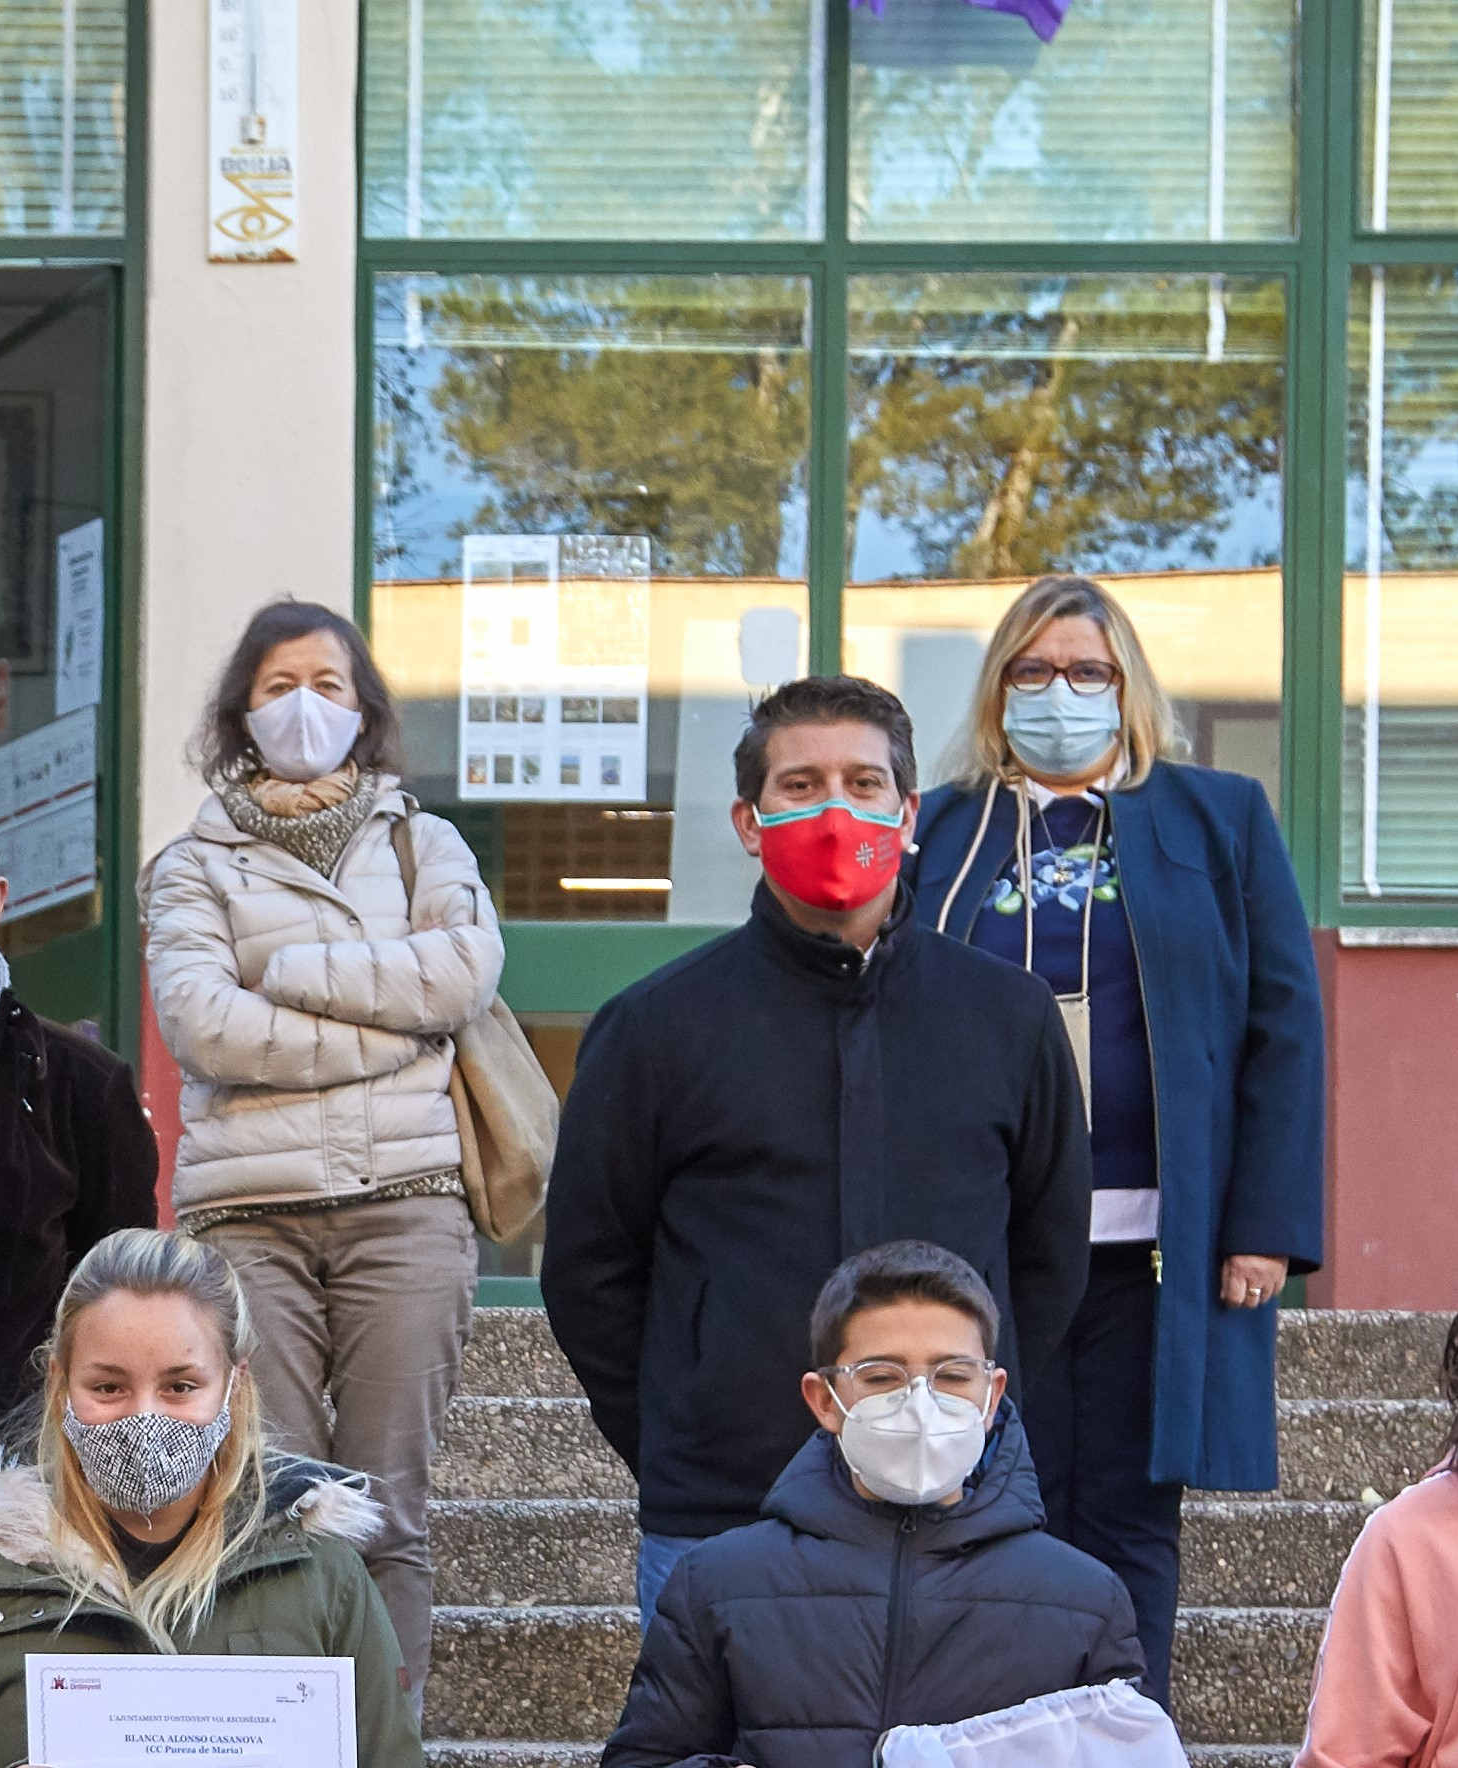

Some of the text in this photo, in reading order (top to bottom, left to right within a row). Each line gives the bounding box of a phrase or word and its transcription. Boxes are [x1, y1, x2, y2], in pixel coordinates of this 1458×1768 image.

[124, 1734, 262, 1744] BLANCA ALONSO CASANOVA
[146, 1745, 162, 1754] (CC
[165, 1745, 196, 1754] Pureza
[198, 1745, 209, 1754] de
